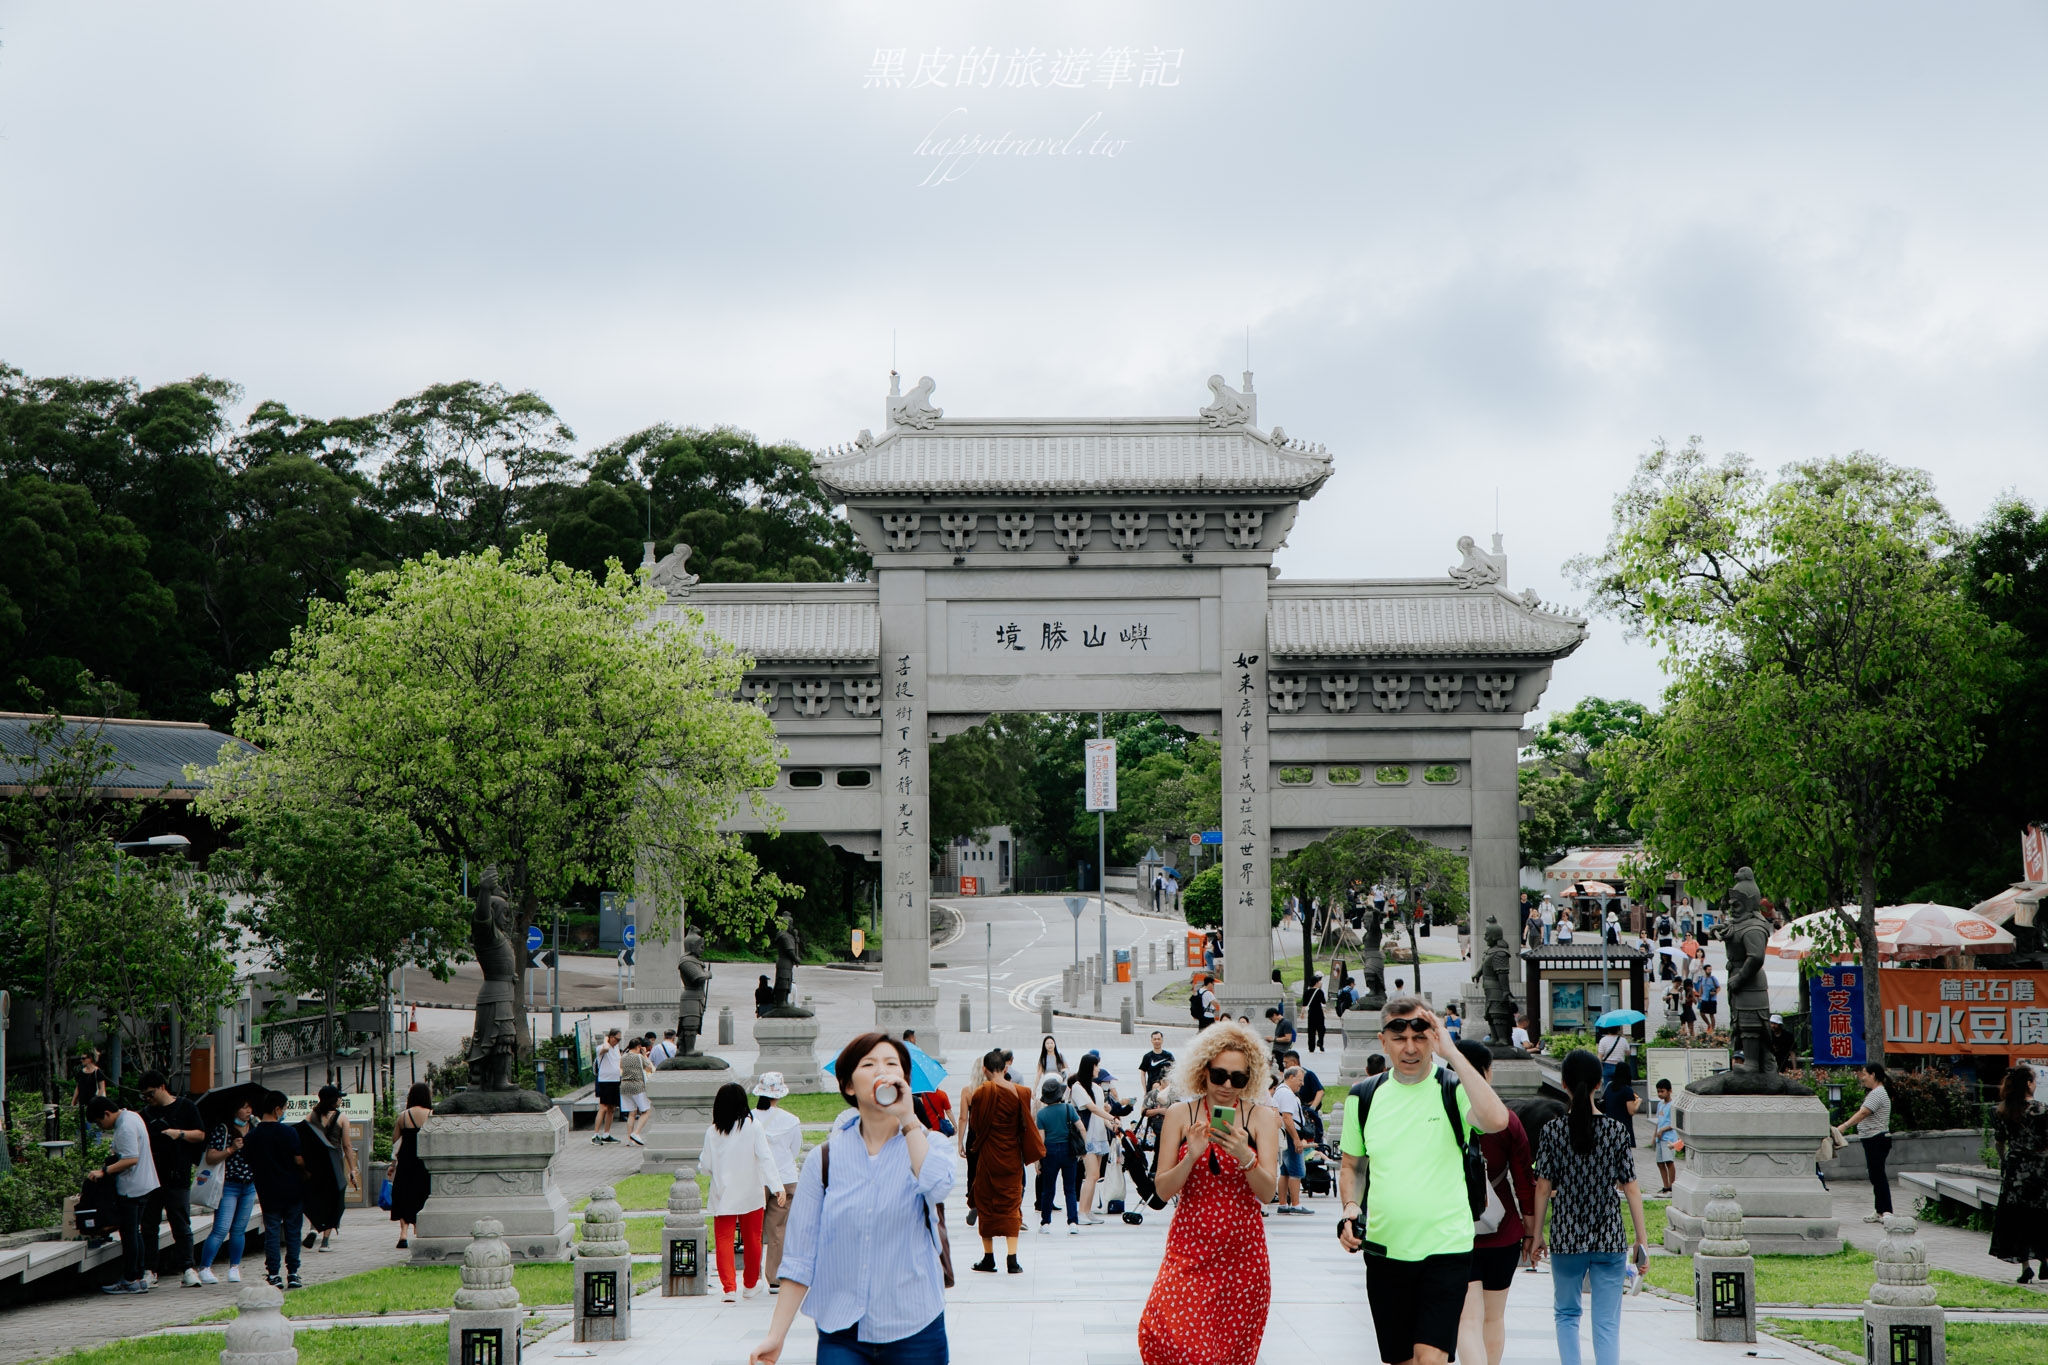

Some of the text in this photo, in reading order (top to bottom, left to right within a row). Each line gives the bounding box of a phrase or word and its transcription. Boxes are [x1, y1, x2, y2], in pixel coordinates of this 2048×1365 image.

[1821, 973, 1855, 987] 生磨
[1940, 978, 2035, 1001] 德記石磨
[1827, 990, 1853, 1058] 芝麻糊
[1885, 1005, 2048, 1045] 山水豆腐
